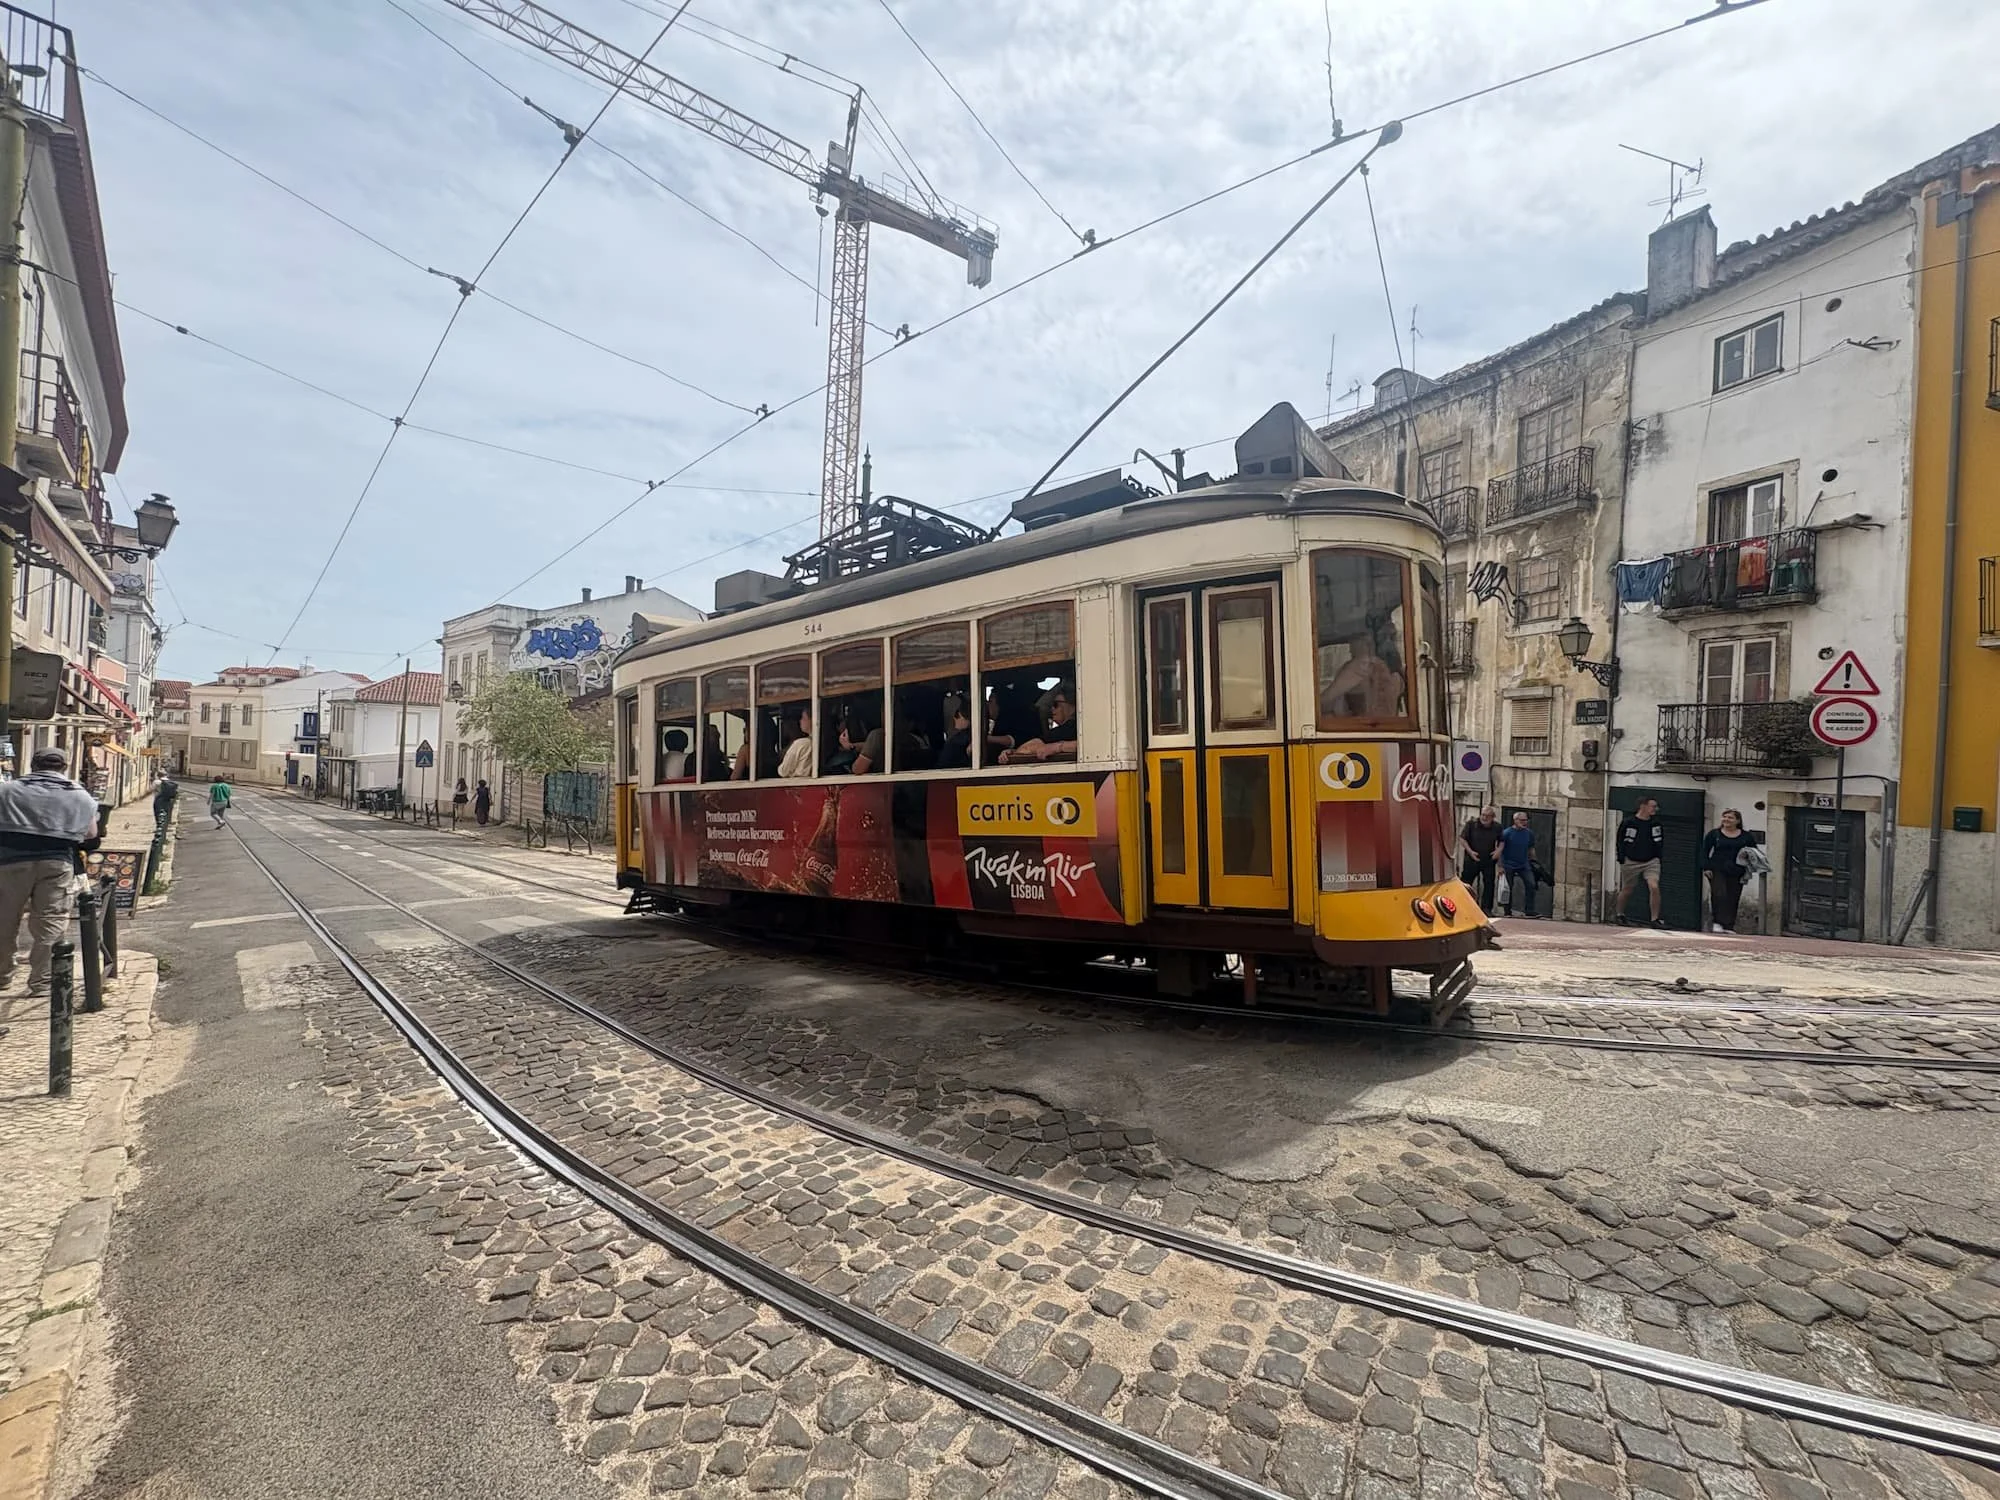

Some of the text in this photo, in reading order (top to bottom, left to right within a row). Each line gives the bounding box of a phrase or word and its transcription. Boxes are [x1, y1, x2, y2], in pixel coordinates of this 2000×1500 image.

[803, 623, 823, 636] 544
[969, 796, 1034, 821] carris
[1818, 797, 1830, 807] 33
[727, 811, 740, 825] para
[737, 829, 750, 842] para
[964, 846, 1097, 897] Rock in Rio
[1010, 883, 1045, 900] LISBOA
